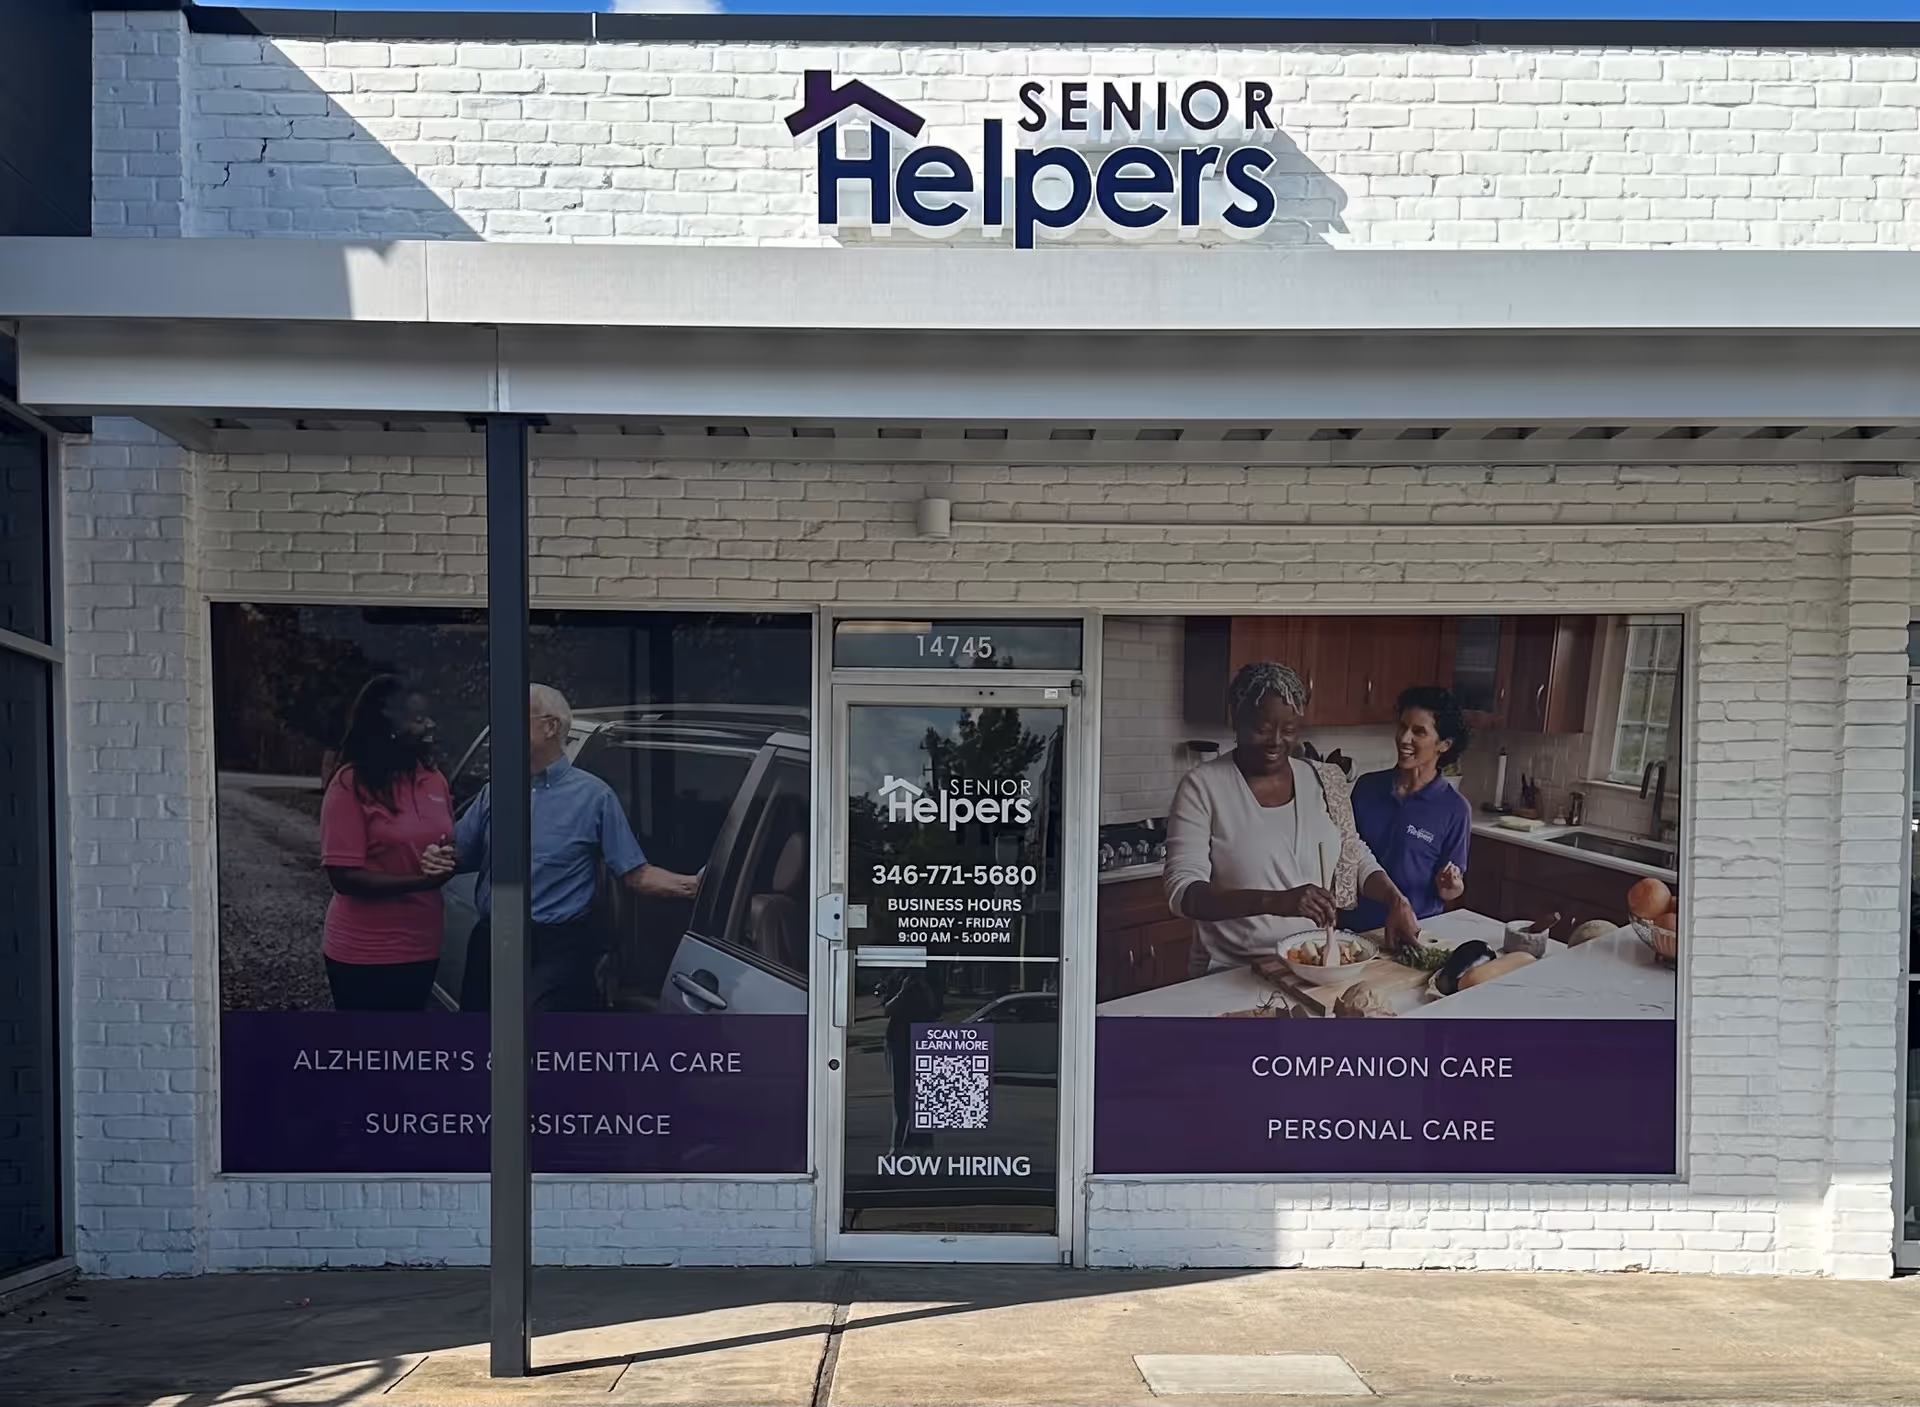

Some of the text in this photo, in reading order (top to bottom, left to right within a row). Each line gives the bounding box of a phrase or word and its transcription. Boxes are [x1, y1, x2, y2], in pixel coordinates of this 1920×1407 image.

[1017, 80, 1276, 132] SENIOR
[817, 117, 1278, 249] Helpers
[915, 635, 992, 659] 14745
[949, 778, 1032, 796] SENIOR
[888, 789, 1032, 832] Helpers
[872, 864, 1037, 886] 346-771-5680
[887, 898, 1023, 912] BUSINESS HOURS
[897, 917, 955, 929] MONDAY
[965, 917, 1012, 929] FRIDAY
[898, 931, 928, 943] 9:00
[930, 932, 951, 943] AM
[961, 932, 1011, 944] 5:00PM
[915, 1040, 989, 1051] LEARN MORE
[927, 1029, 978, 1040] SCAN TO
[293, 1049, 475, 1072] ALZHEIMER'S
[531, 1051, 660, 1072] EMENTIA
[670, 1051, 743, 1073] CARE
[1251, 1055, 1513, 1078] COMPANION CARE
[365, 1112, 491, 1134] SURGERY
[1268, 1119, 1495, 1141] PERSONAL CARE
[876, 1155, 1031, 1177] NOW HIRING
